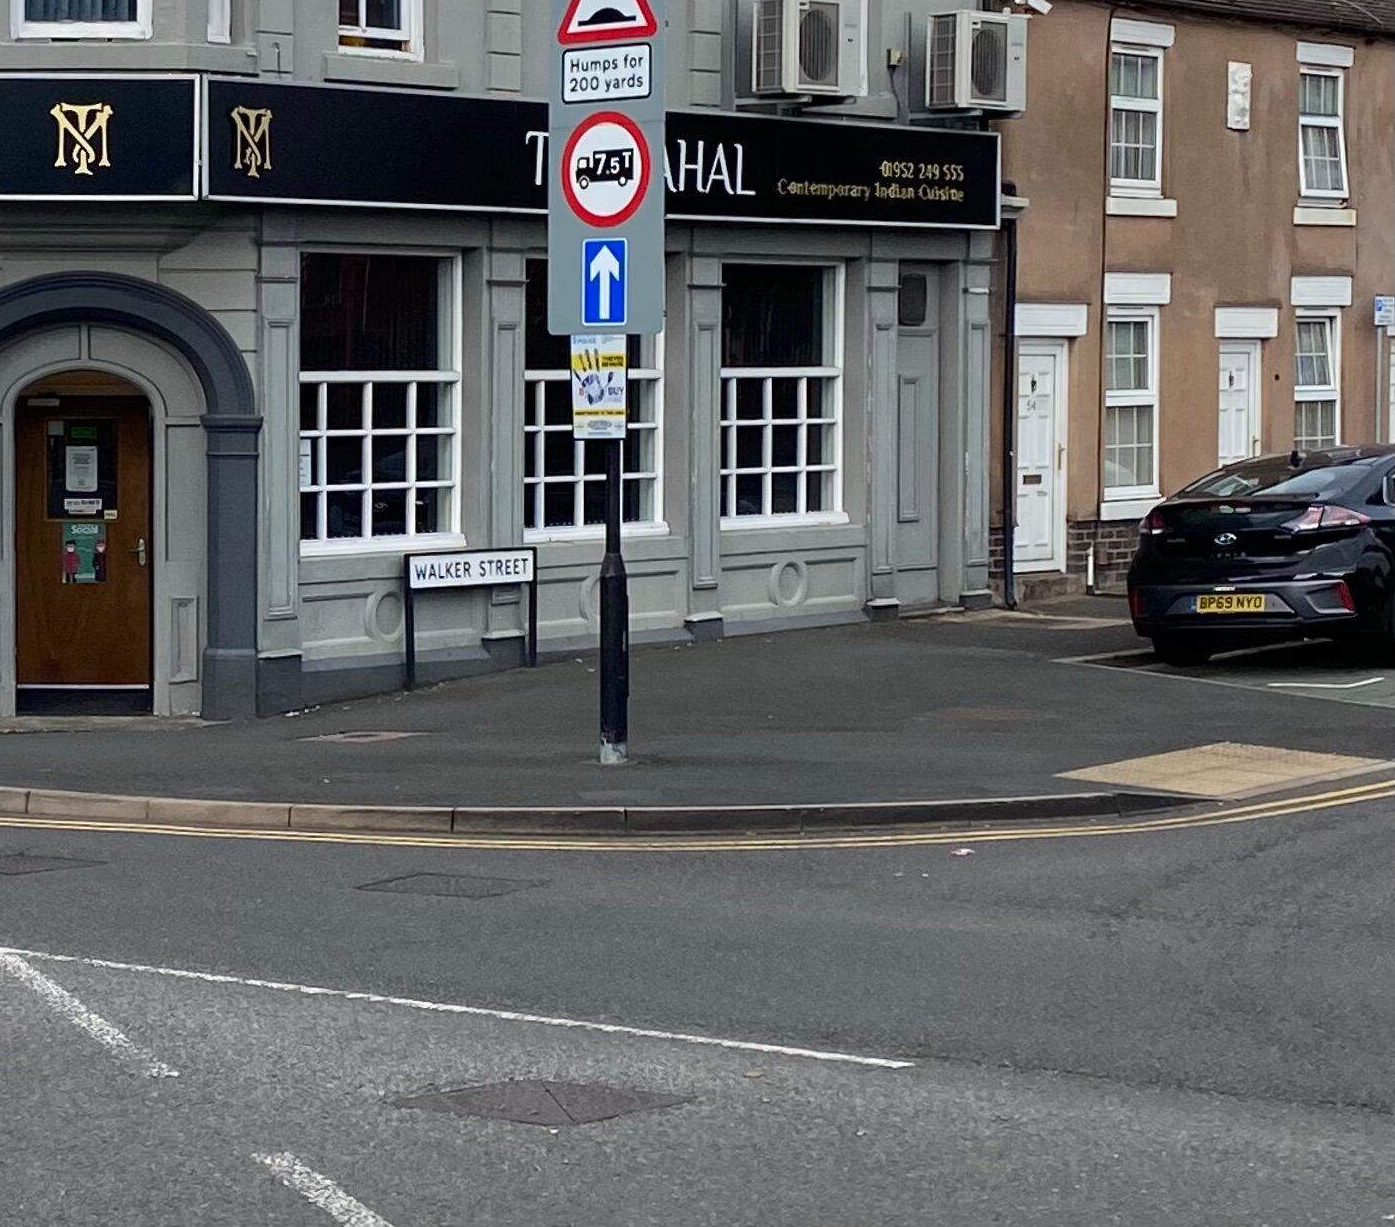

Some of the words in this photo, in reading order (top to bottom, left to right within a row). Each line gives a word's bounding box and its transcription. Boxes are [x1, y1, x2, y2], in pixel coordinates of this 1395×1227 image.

[569, 56, 618, 74] Humps
[623, 54, 644, 68] for
[569, 77, 599, 92] 200
[604, 74, 644, 92] yards
[663, 139, 756, 195] HAL
[880, 160, 914, 178] 01952
[918, 162, 940, 180] 249
[943, 164, 964, 181] 555
[777, 178, 871, 202] Contemporary
[874, 182, 915, 200] Indian
[918, 184, 964, 202] Cuisine
[415, 561, 471, 580] WALKER
[479, 558, 529, 577] STREET
[1199, 596, 1233, 610] BP69
